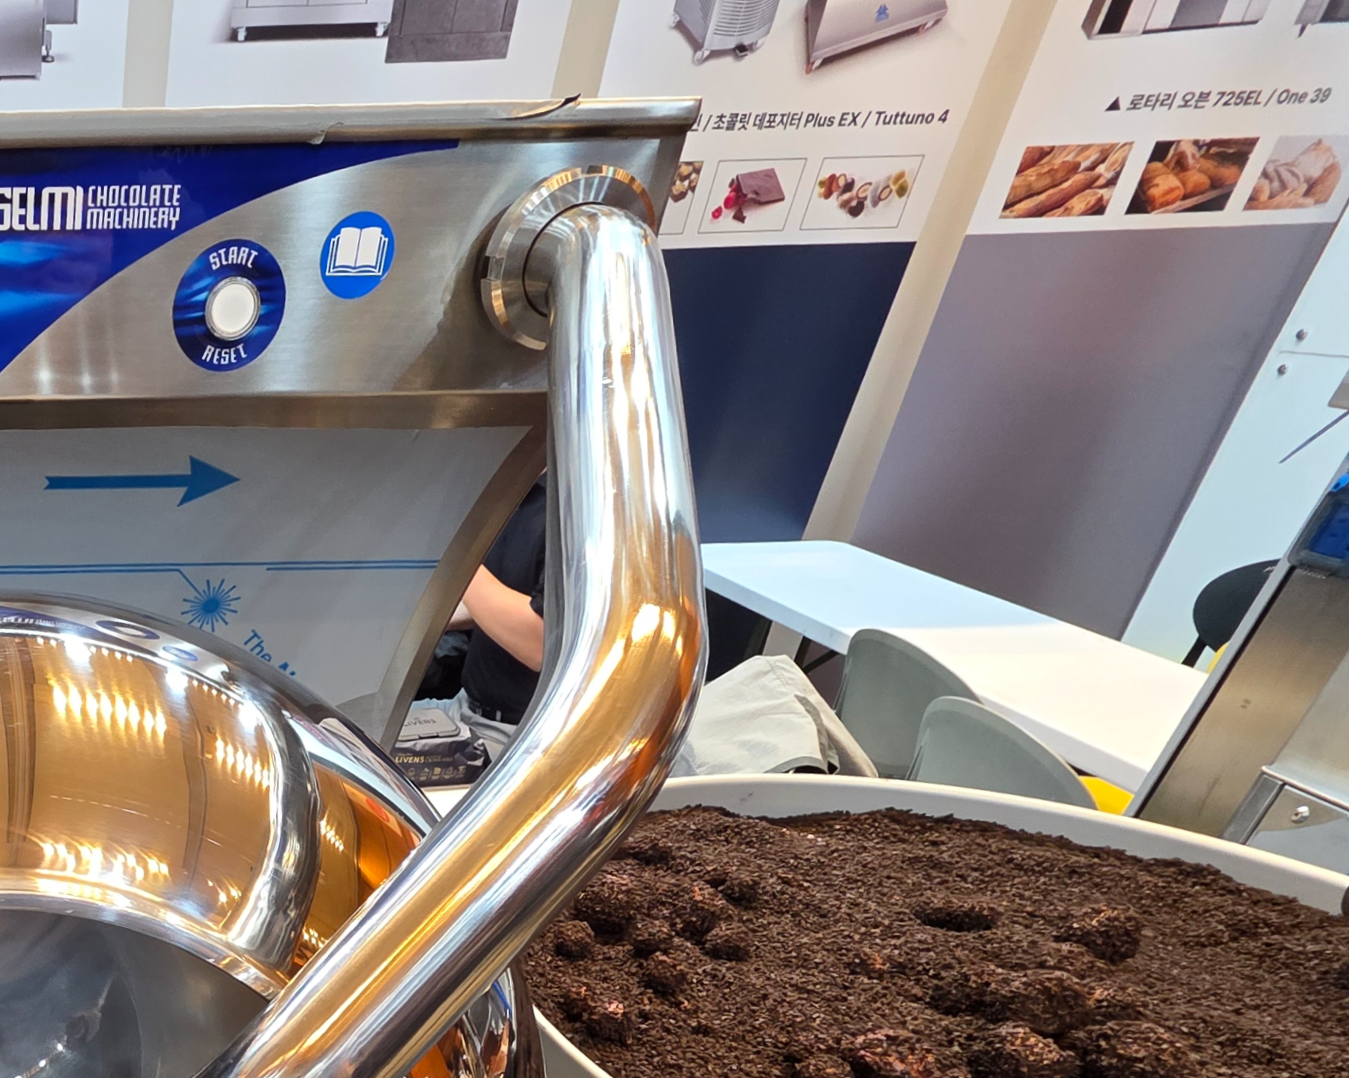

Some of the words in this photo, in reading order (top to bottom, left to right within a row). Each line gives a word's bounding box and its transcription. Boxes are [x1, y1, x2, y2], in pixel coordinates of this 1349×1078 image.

[1126, 91, 1179, 111] 로타리
[1177, 89, 1213, 110] 오븐
[1212, 89, 1263, 108] 725EL
[1276, 87, 1310, 105] One
[1309, 86, 1334, 104] 39
[712, 112, 751, 132] 초콜릿
[752, 111, 804, 131] 데포지터
[803, 111, 835, 129] Plus
[837, 111, 864, 128] EX
[874, 109, 935, 127] Tuttuno
[937, 108, 951, 125] 4
[87, 184, 182, 207] CHOCOLATE
[86, 207, 181, 231] MACHINERY
[208, 245, 259, 271] START
[201, 343, 248, 366] RESET
[243, 628, 273, 663] The
